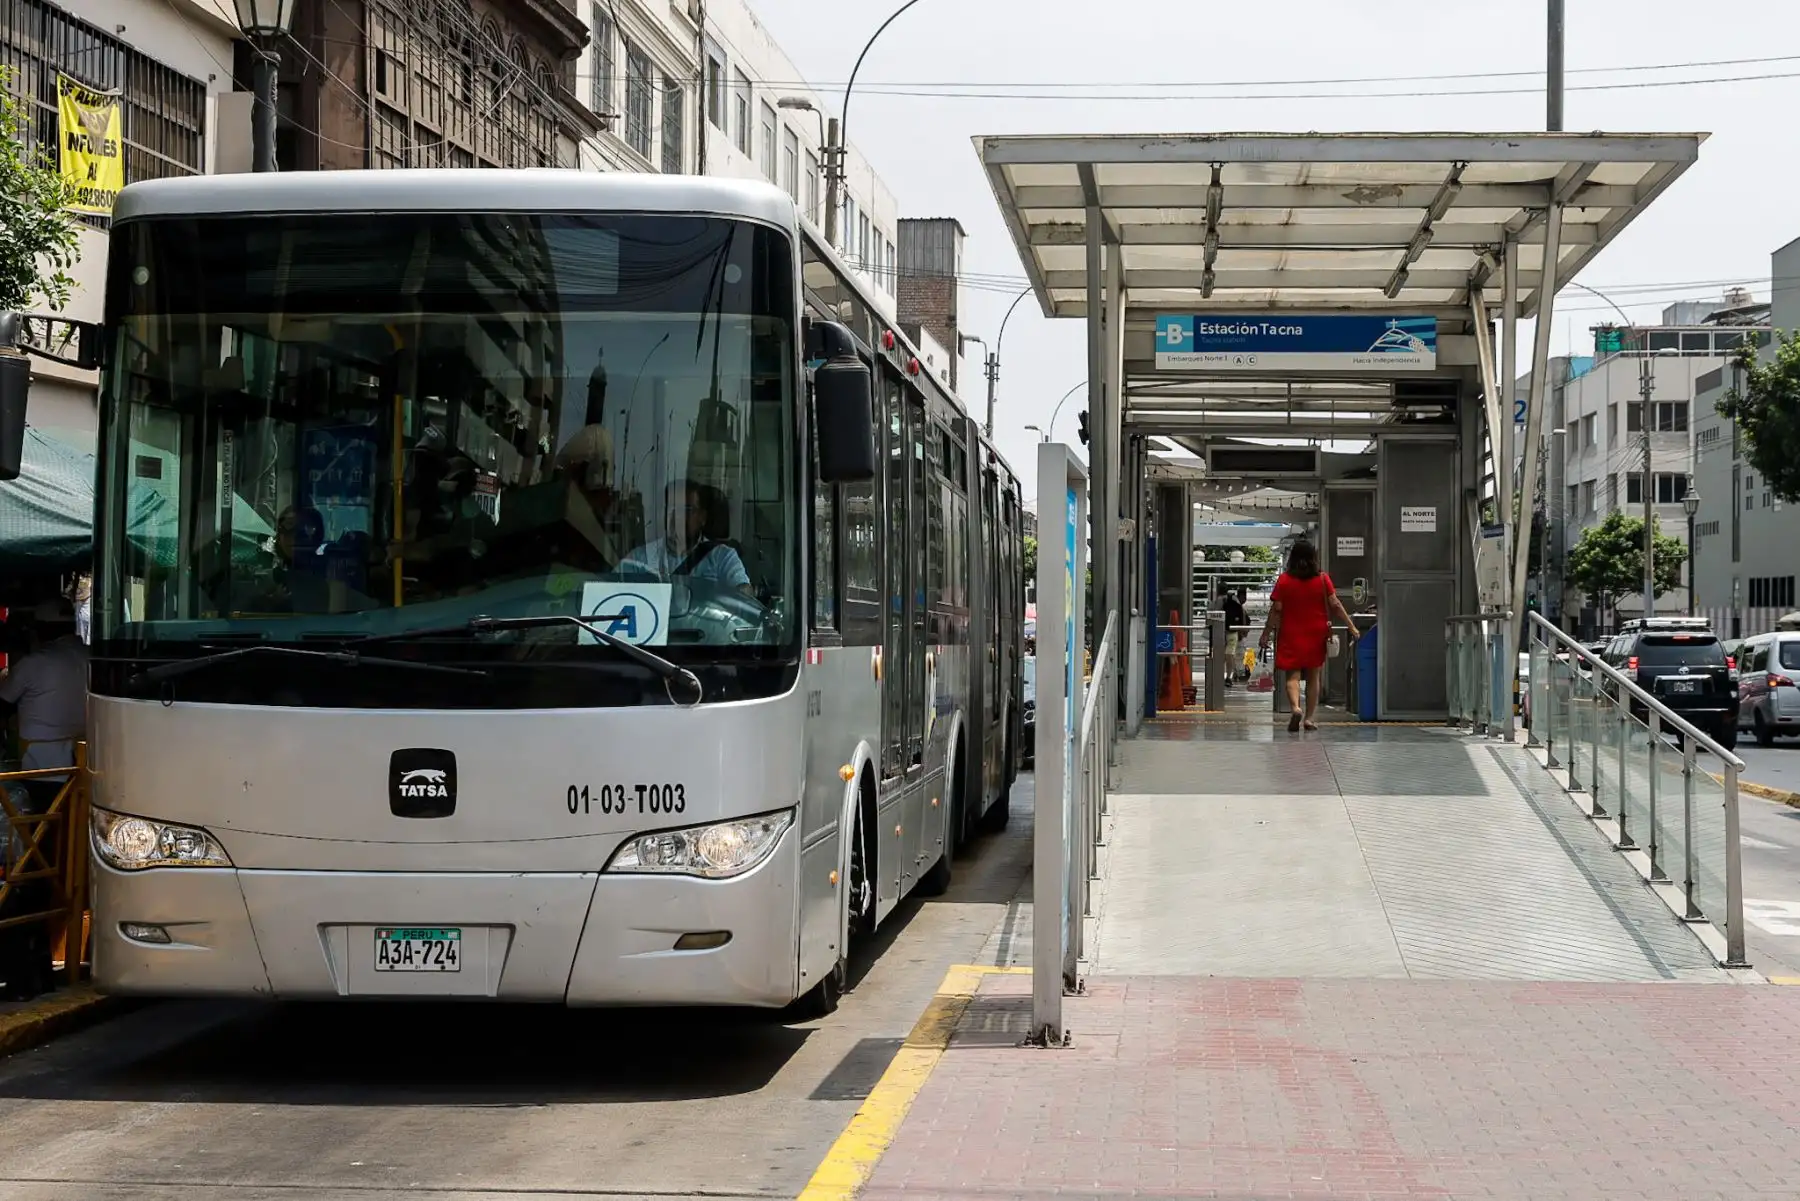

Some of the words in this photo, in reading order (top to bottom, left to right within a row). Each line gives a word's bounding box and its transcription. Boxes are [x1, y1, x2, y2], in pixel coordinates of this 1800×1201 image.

[1167, 323, 1183, 344] B
[1200, 322, 1258, 335] Estación
[1260, 323, 1303, 336] Tacna
[604, 605, 637, 638] A
[399, 784, 448, 797] TATSA
[567, 784, 686, 814] 01-03-T003
[402, 931, 433, 939] PERU
[379, 940, 457, 965] A3A-724
